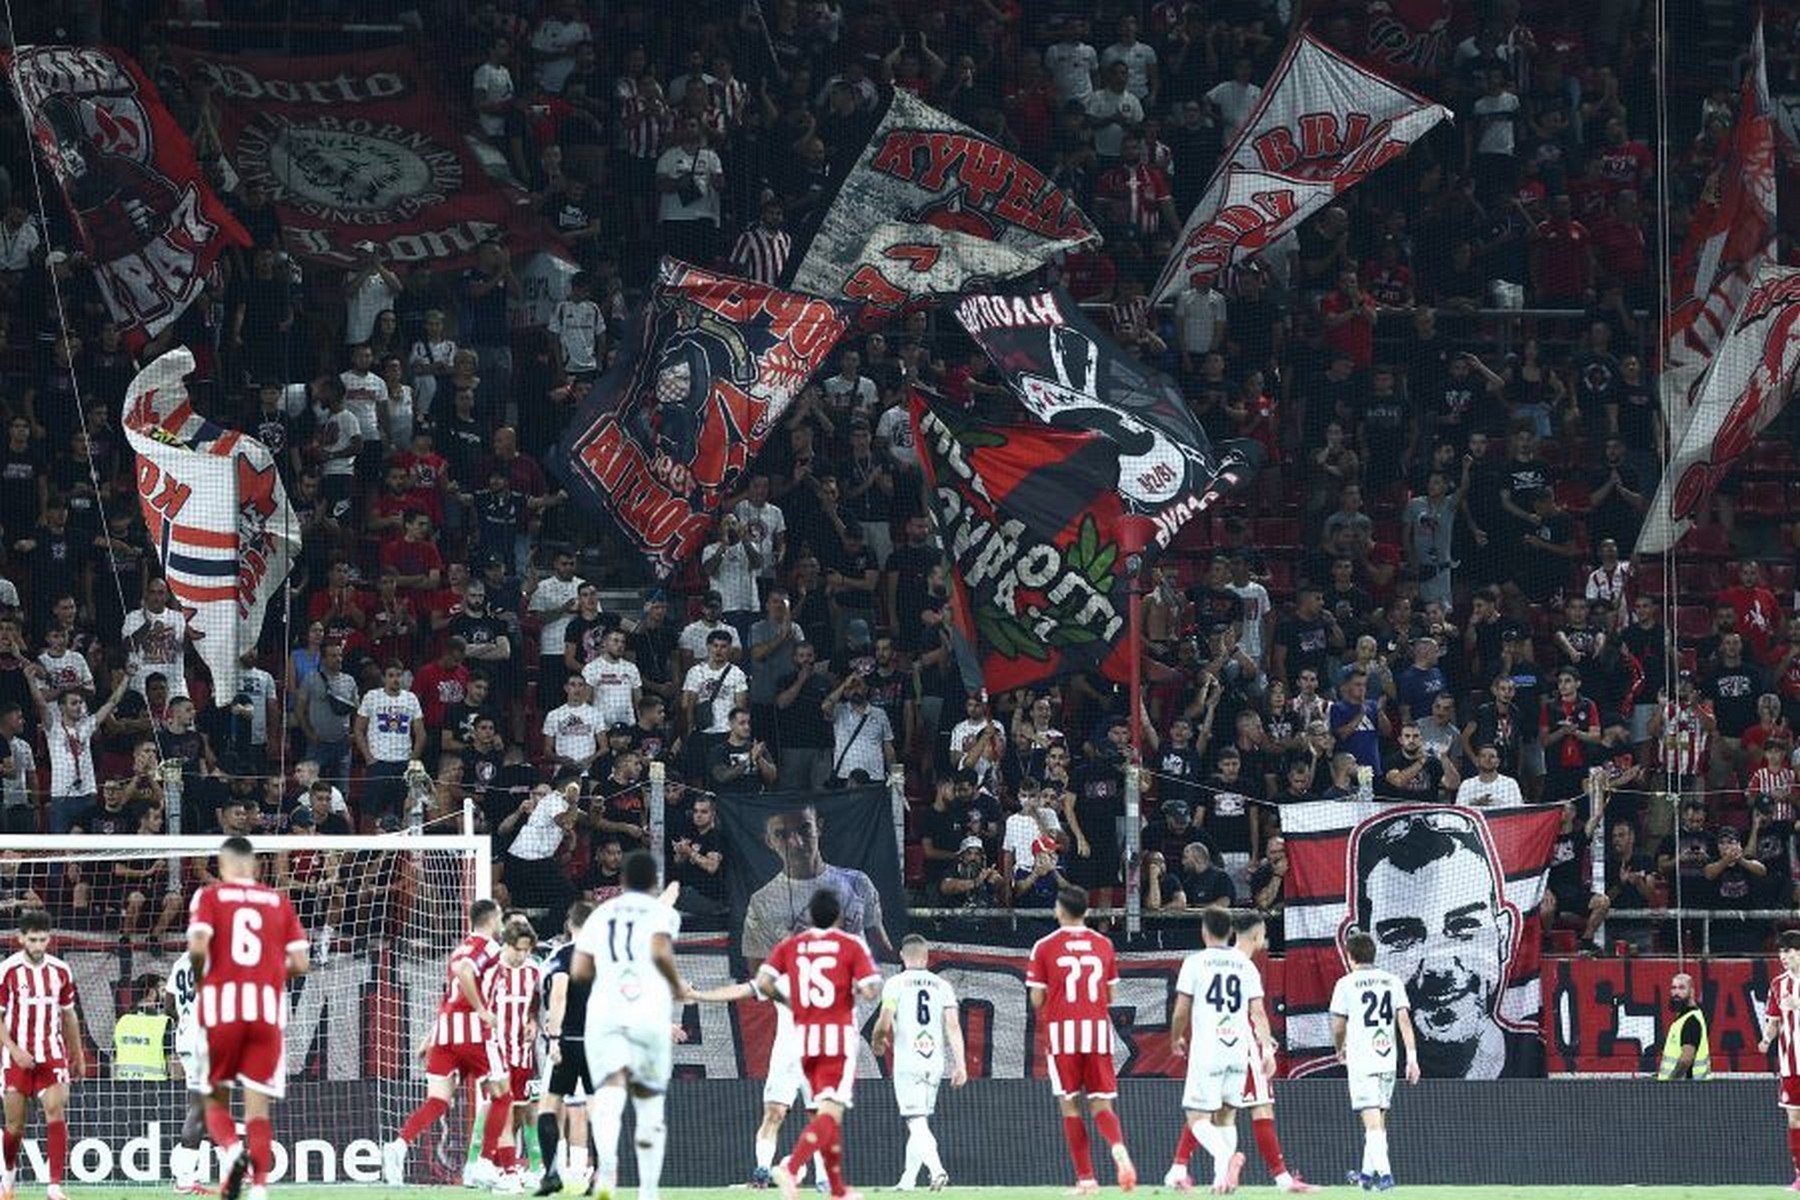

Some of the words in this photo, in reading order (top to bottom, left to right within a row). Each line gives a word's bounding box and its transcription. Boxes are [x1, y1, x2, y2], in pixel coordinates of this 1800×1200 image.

[231, 907, 262, 967] 6
[608, 918, 635, 962] 11
[795, 955, 838, 1009] 15
[1056, 955, 1103, 1003] 77
[1205, 973, 1242, 1013] 49
[917, 989, 931, 1025] 6
[1361, 990, 1394, 1028] 24
